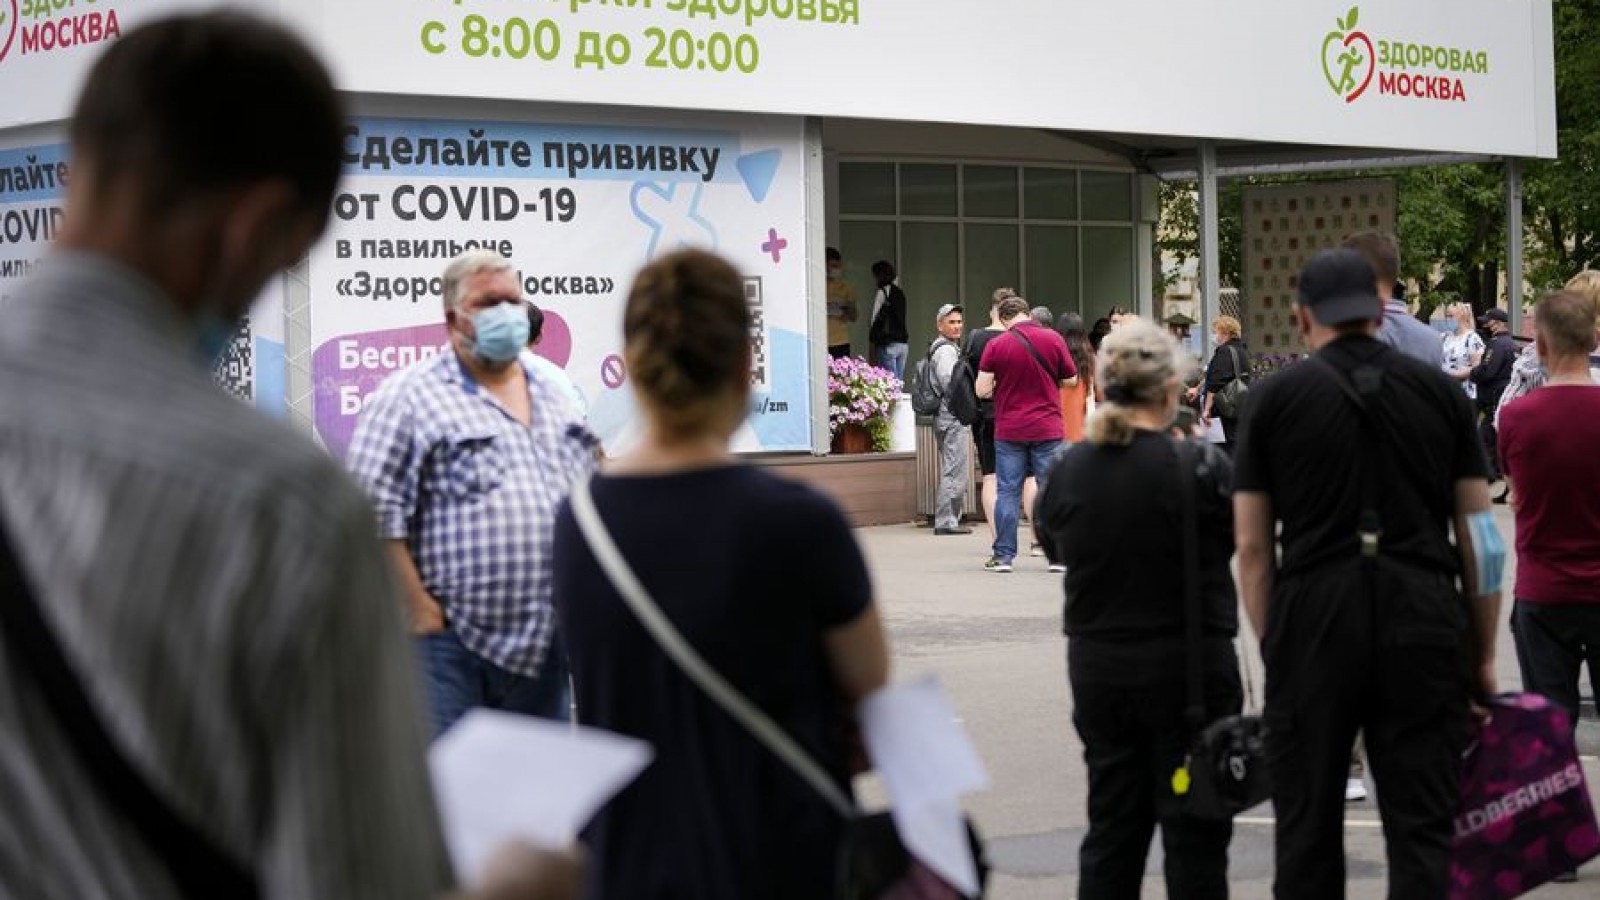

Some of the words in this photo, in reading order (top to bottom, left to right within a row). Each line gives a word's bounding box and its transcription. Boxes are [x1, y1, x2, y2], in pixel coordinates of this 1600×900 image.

[22, 9, 120, 55] МОСКВА
[420, 20, 447, 54] с
[462, 14, 561, 61] 8:00
[574, 31, 631, 70] до
[644, 27, 759, 73] 20:00
[1378, 40, 1487, 73] ЗДОРОВАЯ
[1379, 71, 1465, 101] МОСКВА
[343, 126, 531, 170] Сделайте
[543, 142, 721, 182] прививку
[335, 193, 380, 220] от
[391, 184, 576, 222] COVID-19
[336, 239, 352, 258] в
[339, 340, 450, 369] Беспл
